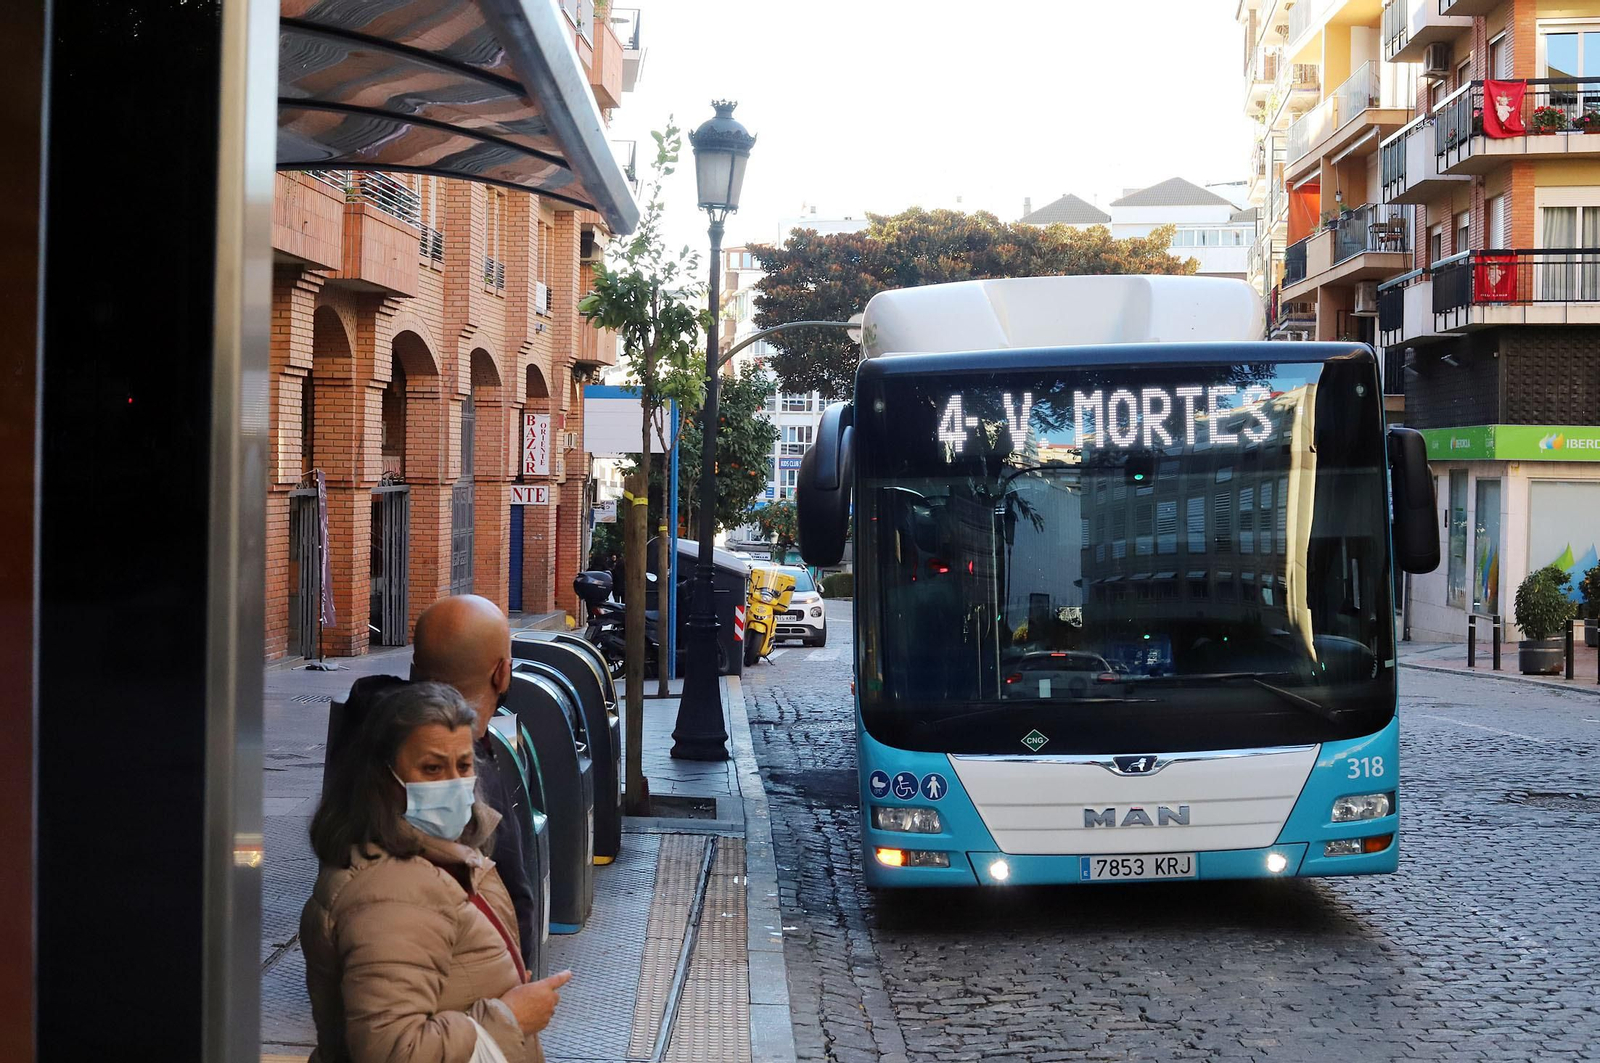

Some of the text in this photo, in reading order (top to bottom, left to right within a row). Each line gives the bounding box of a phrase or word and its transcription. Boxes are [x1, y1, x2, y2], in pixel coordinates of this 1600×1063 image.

[1074, 385, 1272, 449] MORTES
[526, 414, 536, 474] BAZAR
[512, 487, 545, 503] NTE
[1026, 736, 1044, 745] CNG
[1347, 756, 1384, 779] 318
[1084, 805, 1190, 828] MAN
[1096, 858, 1144, 878] 7853
[1155, 856, 1191, 876] KRJ
